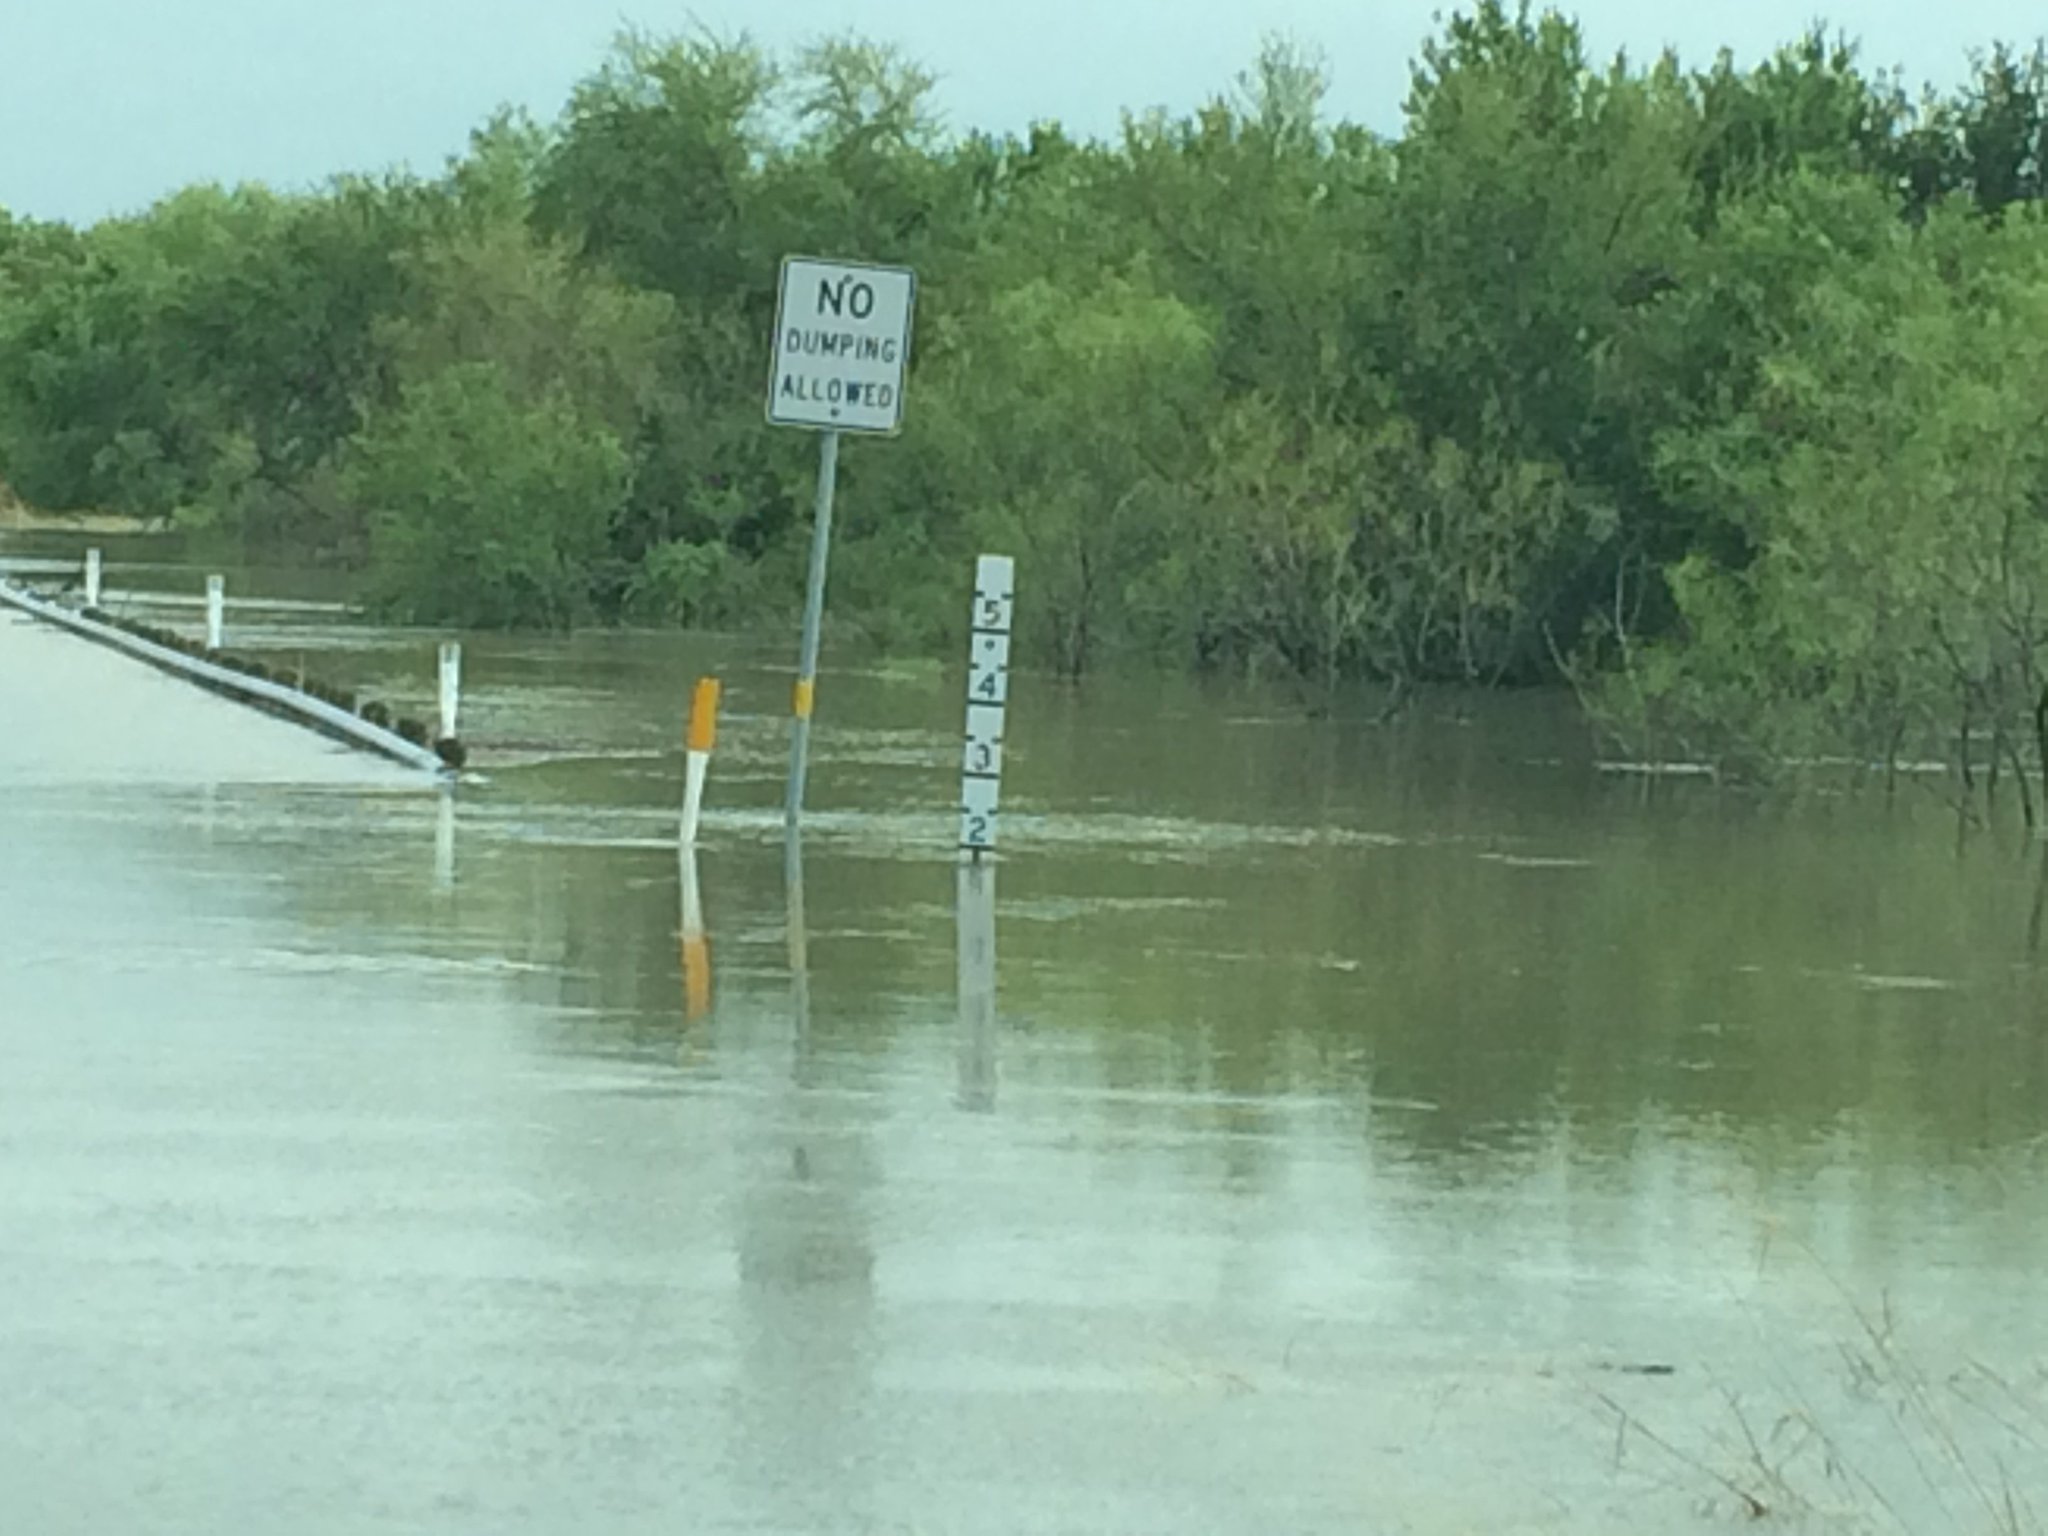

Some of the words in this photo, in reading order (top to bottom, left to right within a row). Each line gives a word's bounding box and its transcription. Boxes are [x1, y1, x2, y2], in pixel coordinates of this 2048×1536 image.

[818, 278, 873, 319] NO
[786, 327, 896, 363] DUMPING
[781, 373, 893, 408] ALLOWED
[984, 600, 1001, 626] 5
[978, 672, 995, 698] 4
[974, 744, 991, 770] 3
[969, 816, 986, 842] 2
